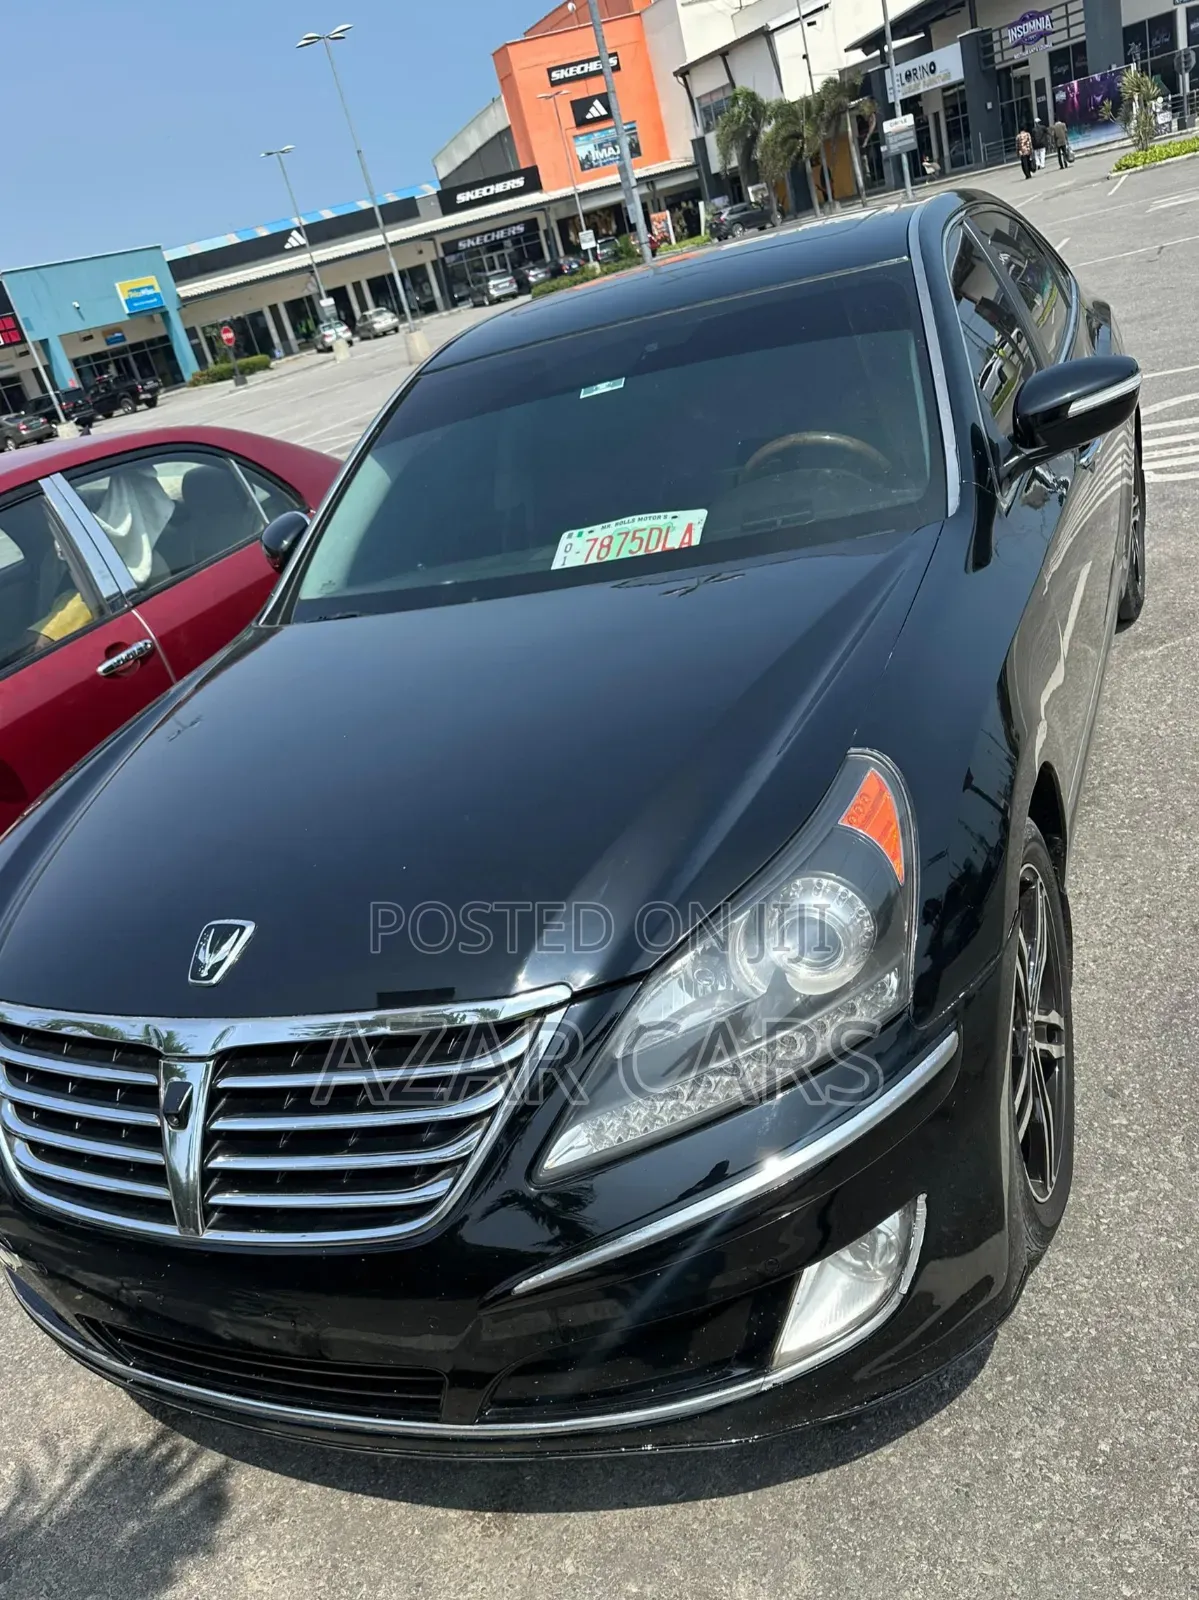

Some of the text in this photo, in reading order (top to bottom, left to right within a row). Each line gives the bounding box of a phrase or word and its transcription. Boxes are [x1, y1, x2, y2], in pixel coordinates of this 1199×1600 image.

[1008, 14, 1053, 44] INSOMNIA
[551, 56, 618, 81] SKECHES
[456, 177, 525, 204] SKECHERS
[458, 223, 525, 250] SKECHERS
[615, 518, 636, 527] ROLLS
[584, 522, 694, 564] 7875DLA
